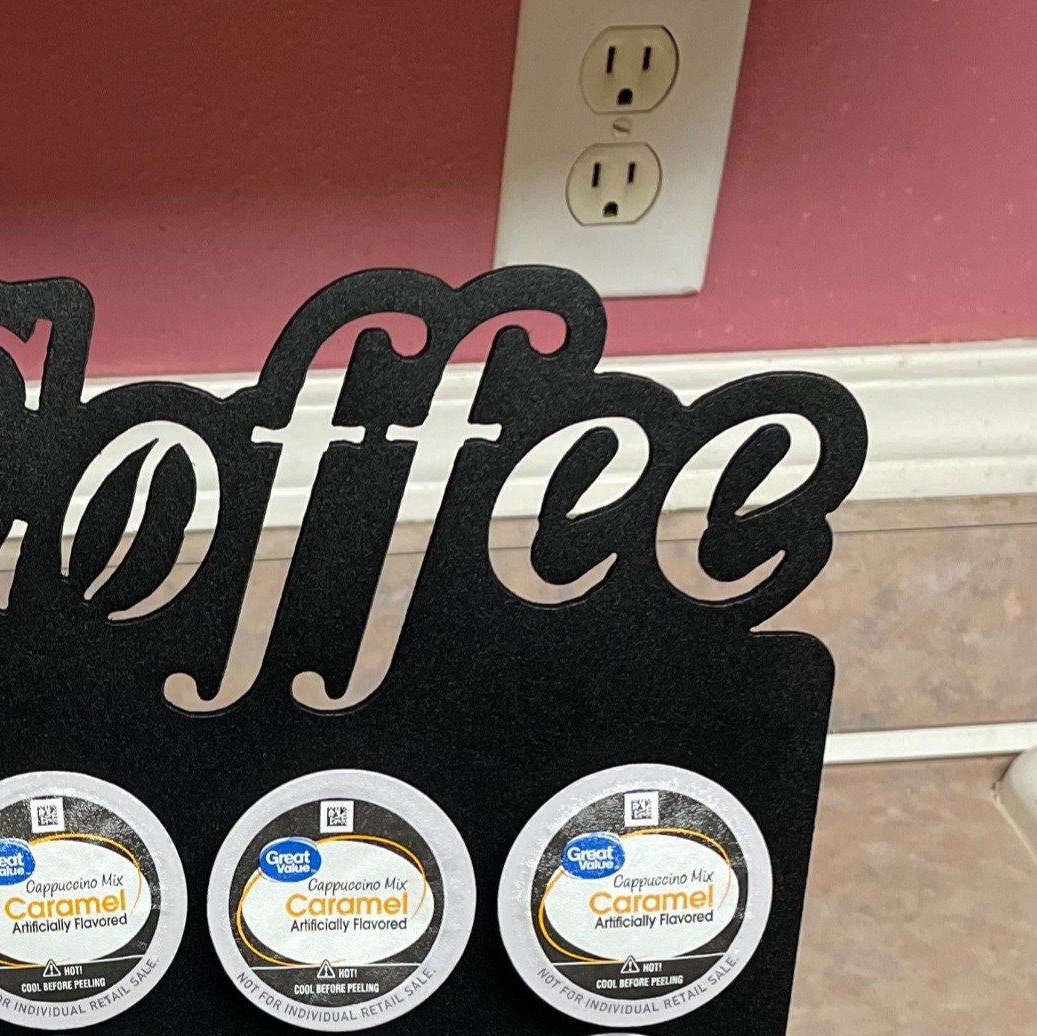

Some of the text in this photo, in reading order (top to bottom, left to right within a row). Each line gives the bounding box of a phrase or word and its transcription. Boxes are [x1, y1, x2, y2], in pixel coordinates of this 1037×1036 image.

[266, 850, 310, 866] Great
[567, 846, 613, 863] Great
[277, 864, 310, 873] Value
[579, 860, 613, 870] Value
[26, 873, 124, 898] Cappuccino Mix
[308, 877, 408, 897] Cappuccino Mix
[614, 869, 714, 893] Cappuccino Mix
[4, 888, 126, 920] Caramel
[285, 890, 408, 917] Caramel
[589, 884, 715, 915] Caramel
[12, 912, 127, 934] Artificially Flavored
[289, 916, 407, 933] Artificially Flavored
[595, 909, 714, 929] Artificially Flavored
